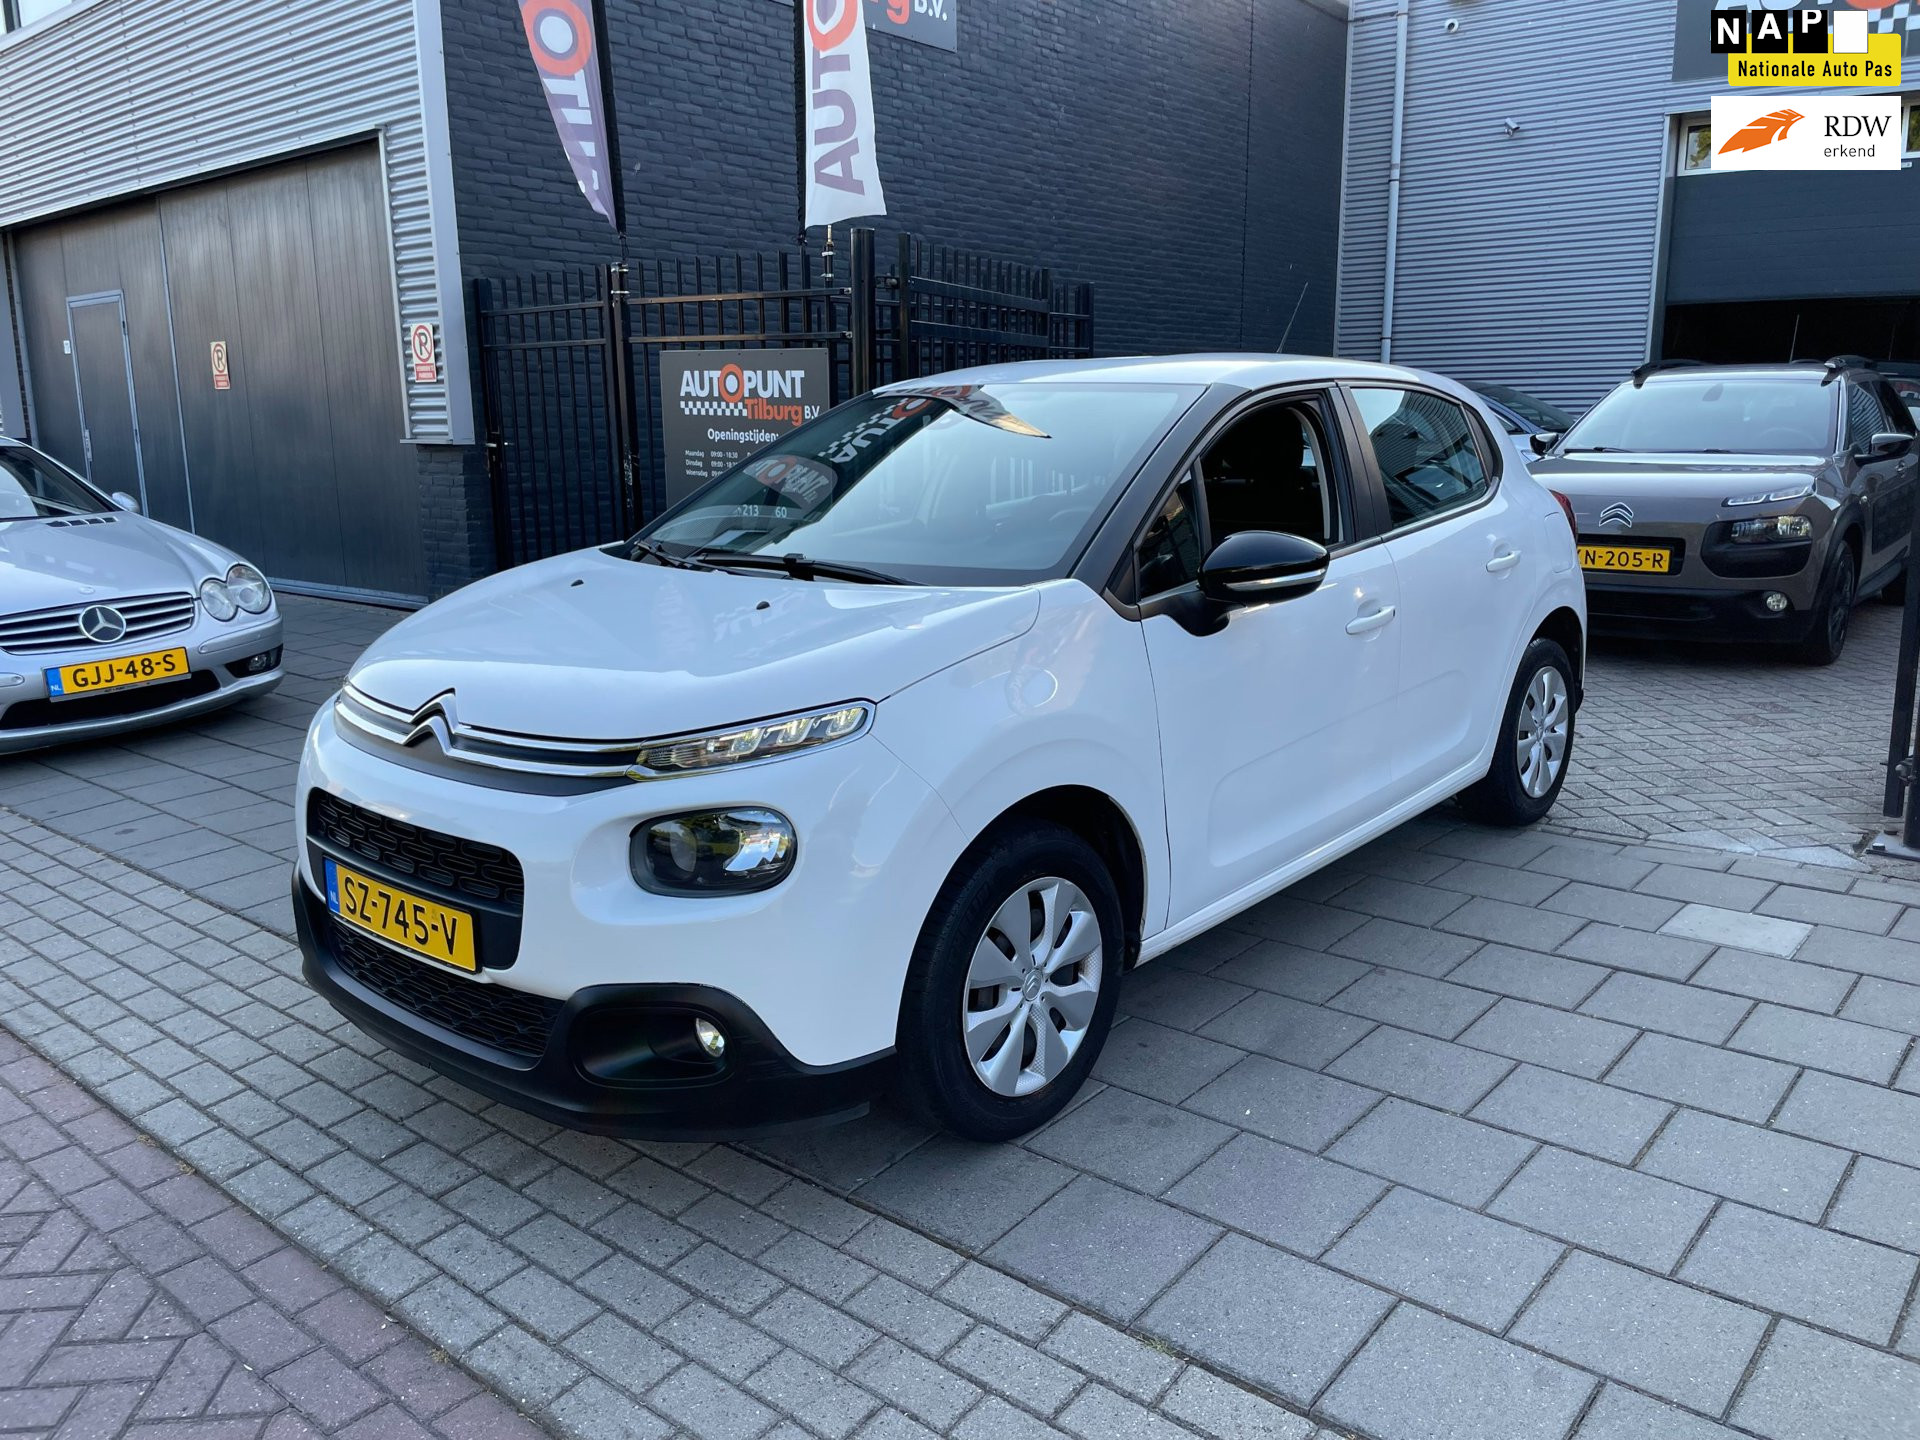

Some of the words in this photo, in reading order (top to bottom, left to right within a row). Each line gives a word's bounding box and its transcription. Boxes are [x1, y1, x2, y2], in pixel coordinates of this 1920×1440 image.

[680, 363, 805, 403] AUTOPUNT
[744, 398, 803, 427] Tilburg
[1578, 549, 1664, 569] N-205-R
[51, 684, 62, 692] NL
[72, 653, 176, 688] GJJ-48-S
[344, 875, 457, 956] SZ-745-V
